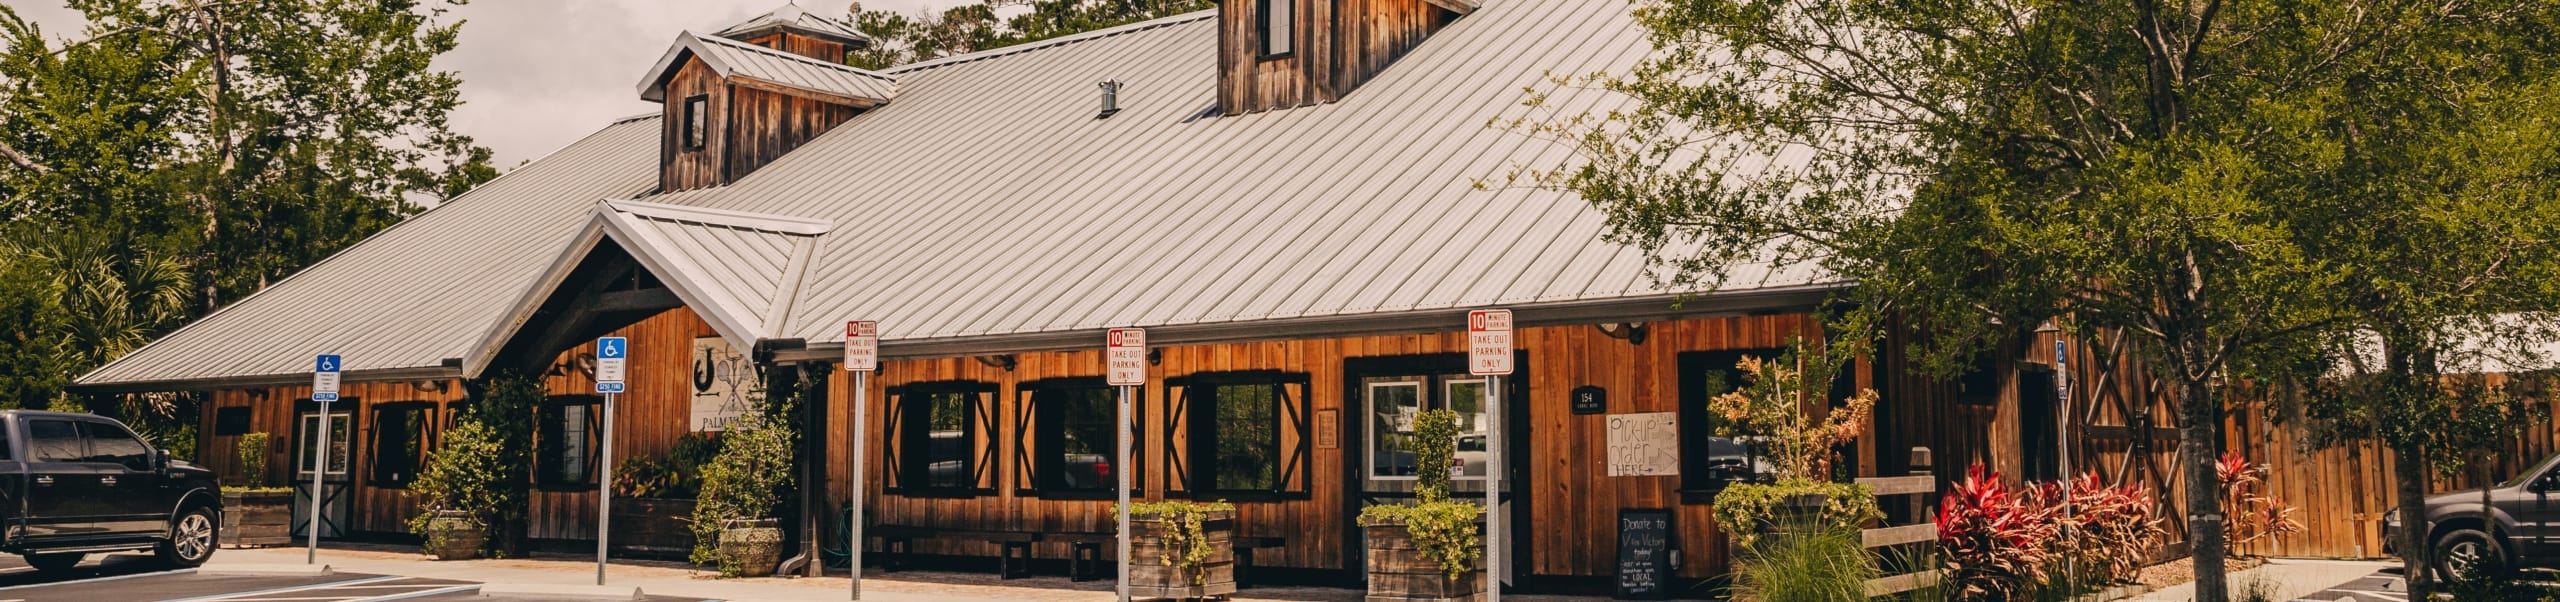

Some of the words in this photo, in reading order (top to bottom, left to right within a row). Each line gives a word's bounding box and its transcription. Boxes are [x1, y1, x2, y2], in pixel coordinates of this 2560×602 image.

[1472, 314, 1485, 329] 10
[849, 323, 858, 335] 10
[1110, 332, 1122, 345] 10
[1474, 335, 1491, 344] TAKE
[1494, 335, 1508, 344] OUT
[1111, 350, 1127, 358] TAKE
[1129, 350, 1141, 358] OUT
[1475, 347, 1507, 356] PARKING
[1112, 360, 1140, 368] PARKING
[1481, 360, 1501, 368] ONLY
[1117, 371, 1135, 379] ONLY
[1581, 393, 1593, 403] 154
[1623, 518, 1652, 532] Donate
[1656, 519, 1666, 530] to
